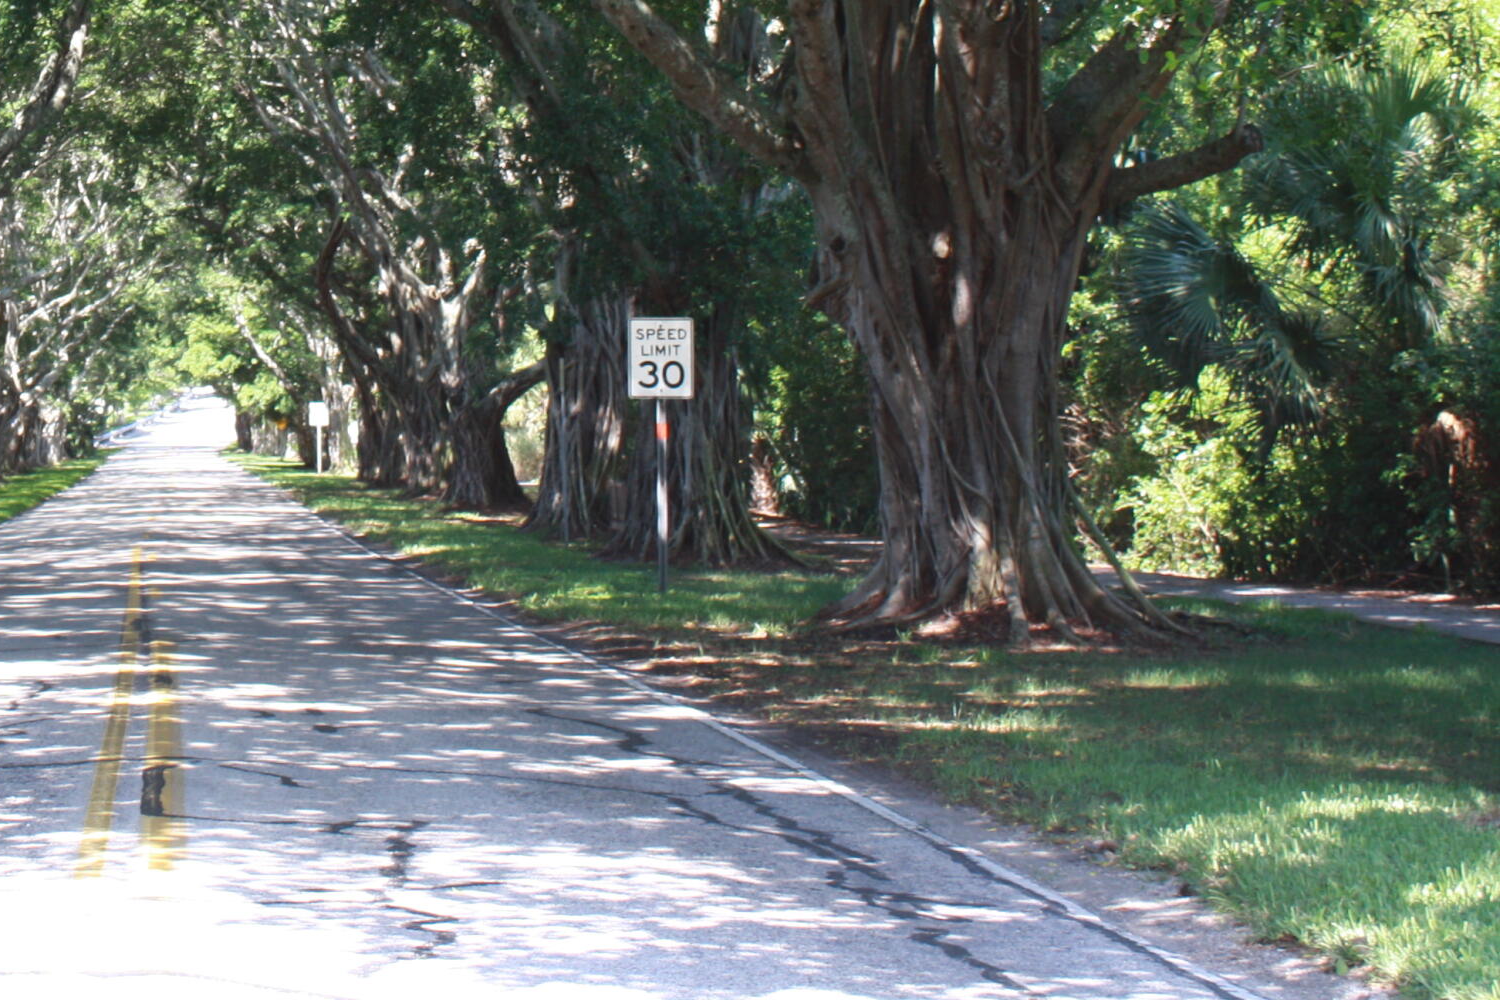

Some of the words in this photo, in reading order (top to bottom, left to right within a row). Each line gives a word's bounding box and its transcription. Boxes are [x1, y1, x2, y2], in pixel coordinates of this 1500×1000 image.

[636, 328, 687, 340] SPEED
[641, 345, 681, 356] LIMIT
[638, 361, 685, 388] 30
